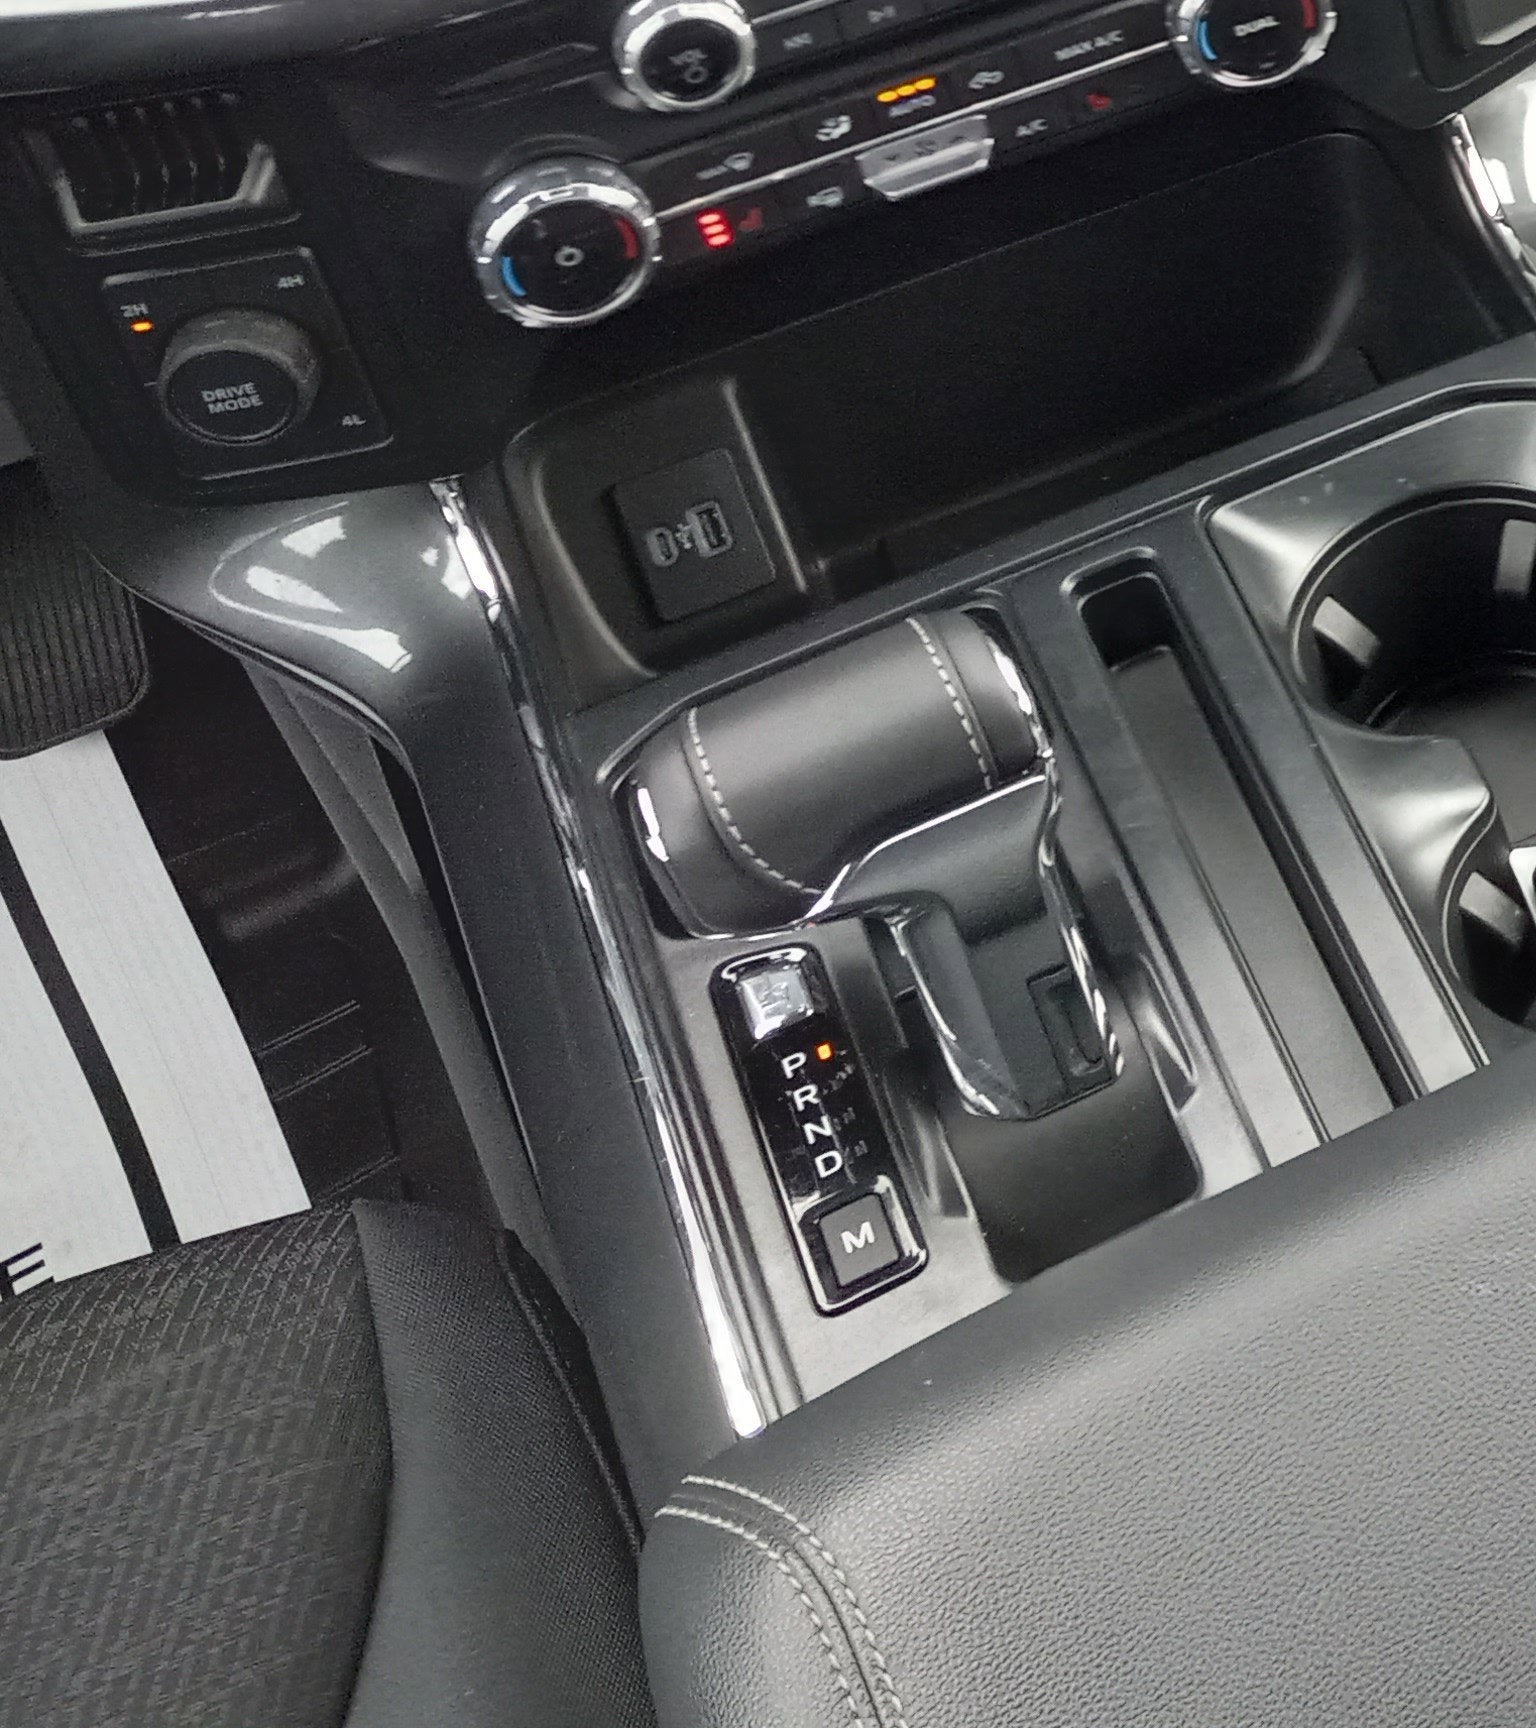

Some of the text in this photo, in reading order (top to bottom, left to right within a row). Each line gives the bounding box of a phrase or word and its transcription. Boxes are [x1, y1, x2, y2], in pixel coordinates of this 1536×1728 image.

[200, 381, 258, 404] DRIVE
[207, 393, 264, 415] MODE
[780, 1051, 808, 1080] P
[792, 1083, 822, 1112] R
[801, 1114, 835, 1146] N
[814, 1149, 844, 1179] D
[840, 1220, 876, 1255] M
